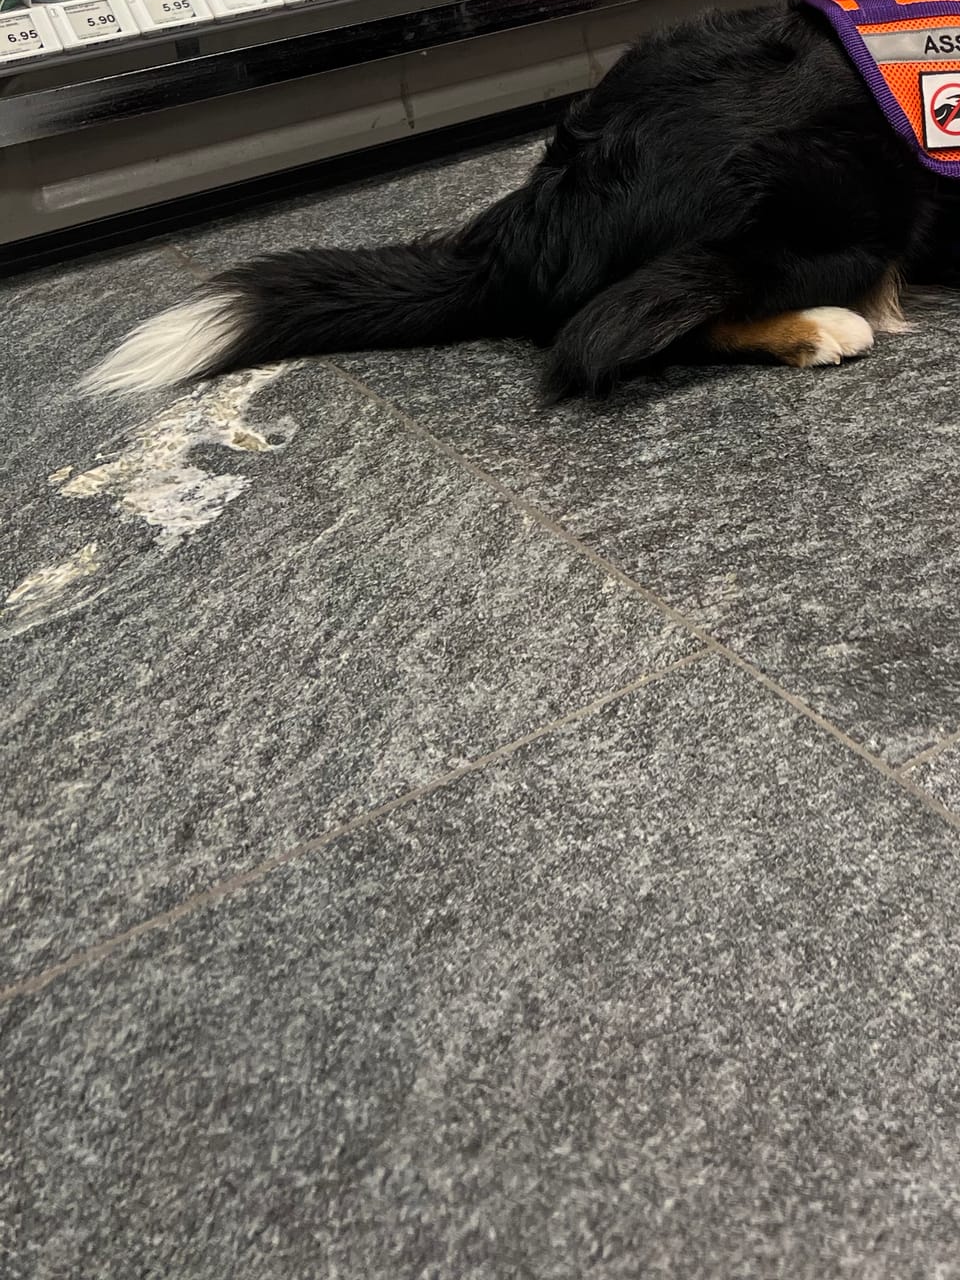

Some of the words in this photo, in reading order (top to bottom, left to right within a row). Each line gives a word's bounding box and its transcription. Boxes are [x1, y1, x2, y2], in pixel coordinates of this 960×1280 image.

[162, 0, 191, 13] 5.95
[87, 13, 116, 28] 5.90
[7, 29, 39, 45] 6.95
